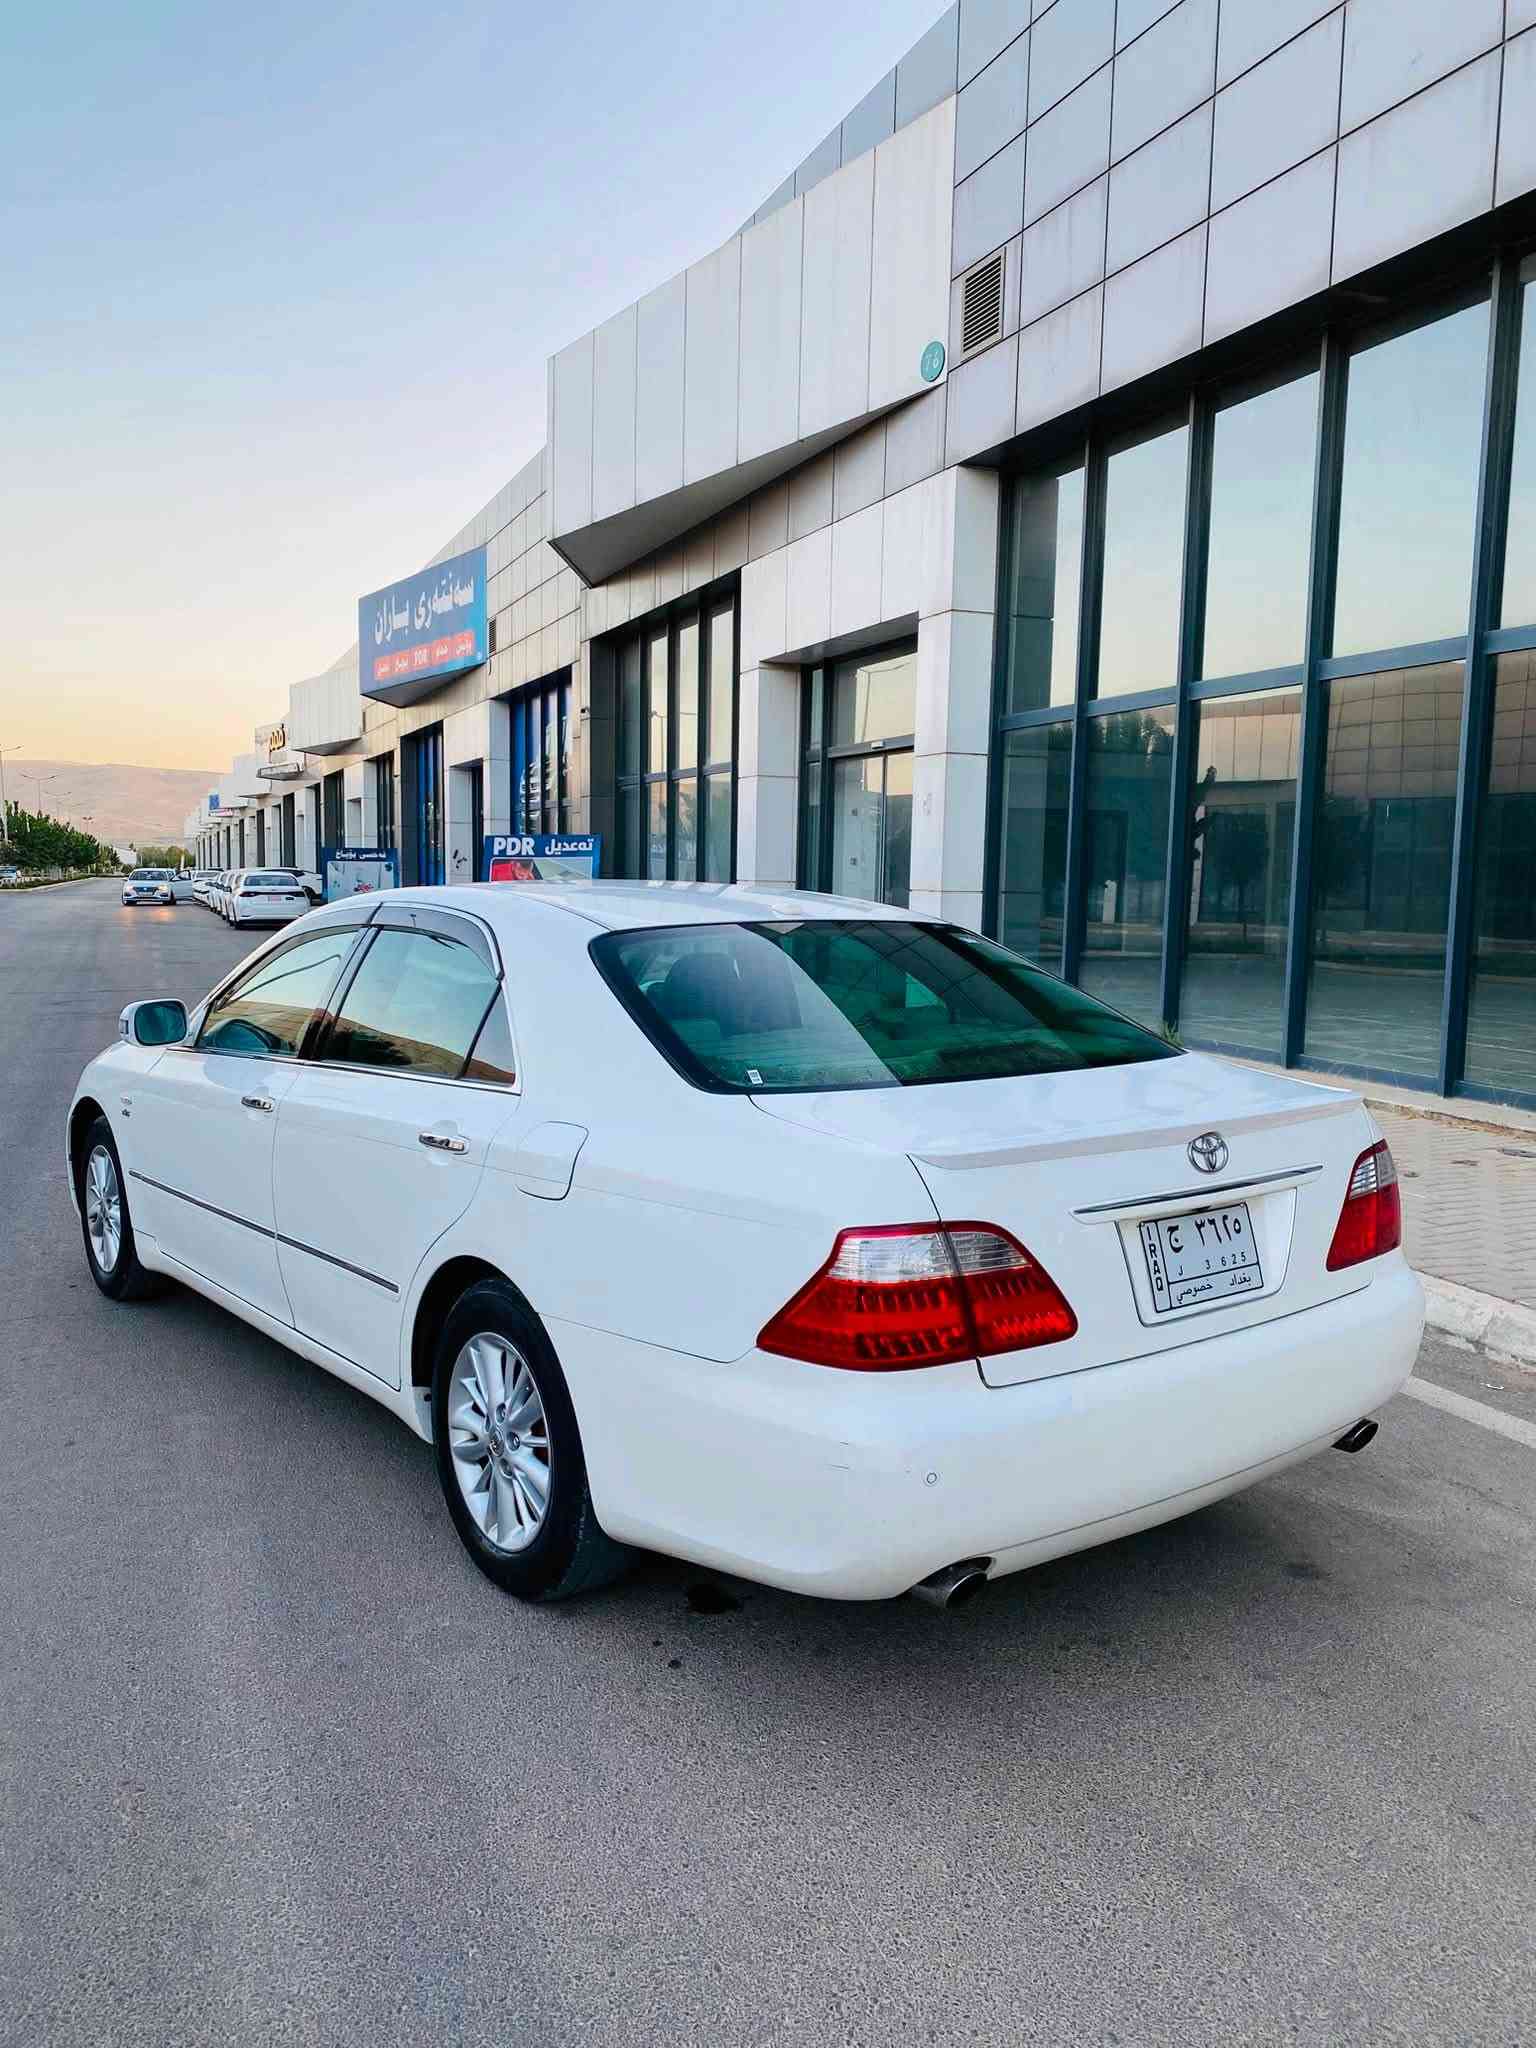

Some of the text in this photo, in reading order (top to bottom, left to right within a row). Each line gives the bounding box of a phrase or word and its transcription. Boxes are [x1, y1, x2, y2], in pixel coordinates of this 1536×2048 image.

[493, 837, 535, 856] PDR
[1195, 1214, 1242, 1246] ٣٦٢٥
[1146, 1226, 1164, 1292] IRAQ
[1230, 1273, 1252, 1286] بغداد
